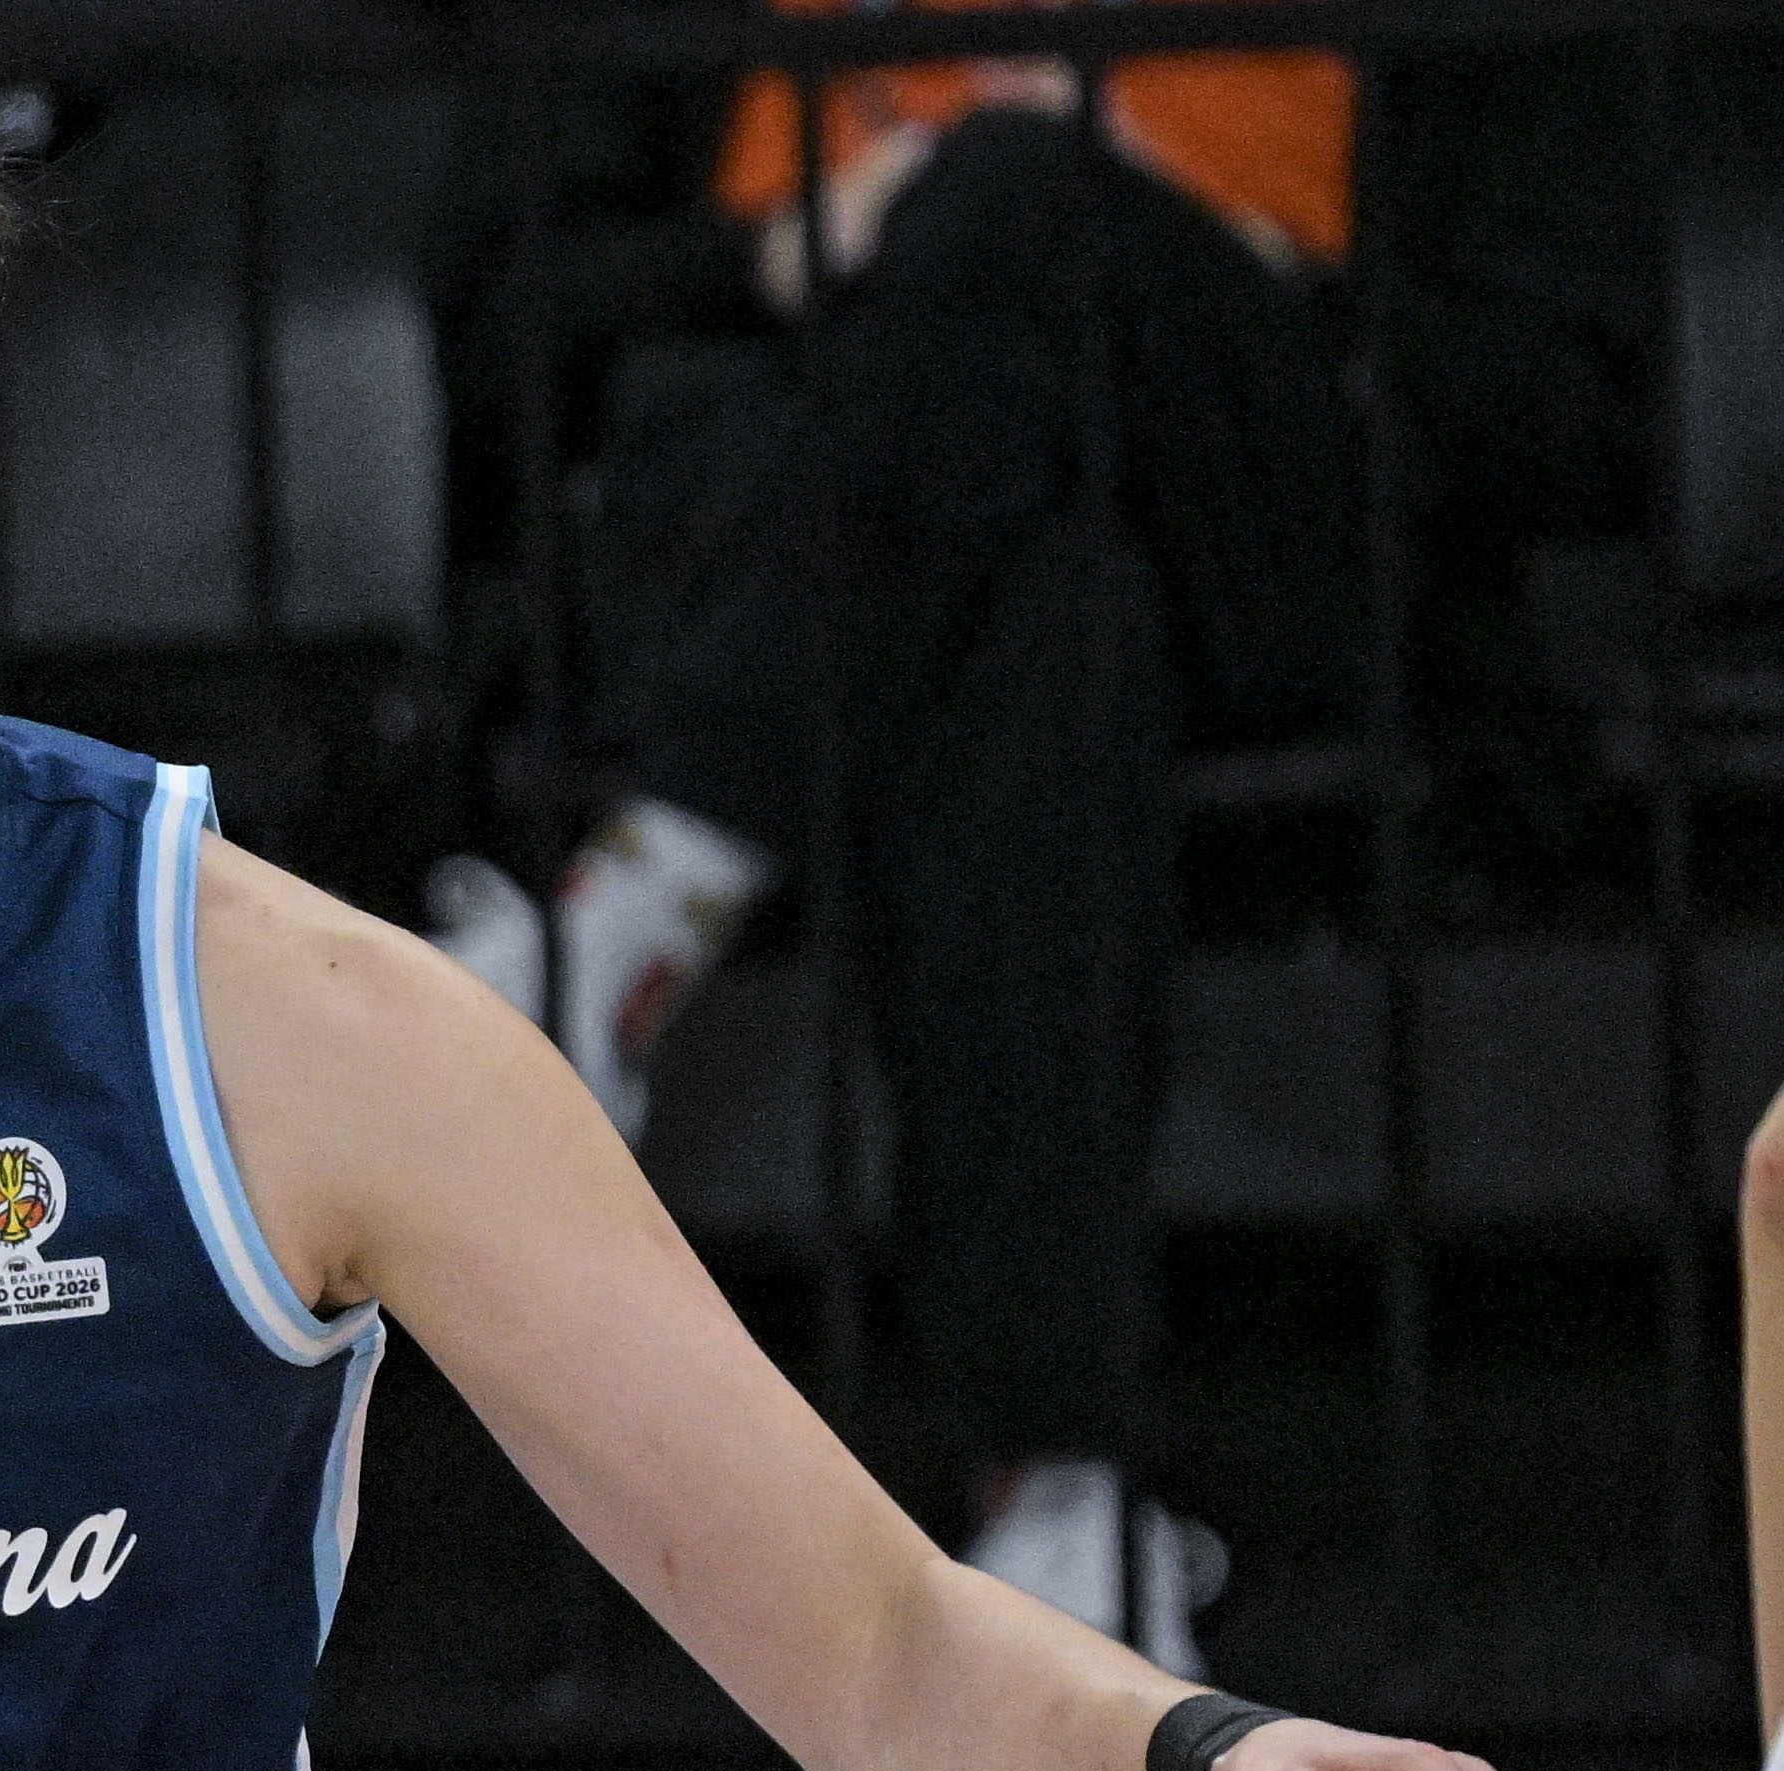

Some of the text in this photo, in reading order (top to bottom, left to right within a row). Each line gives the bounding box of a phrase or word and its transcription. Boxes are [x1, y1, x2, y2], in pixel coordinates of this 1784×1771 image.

[10, 1266, 99, 1286] BASKETBALL
[13, 1283, 51, 1301] CUP
[55, 1278, 101, 1297] 2026
